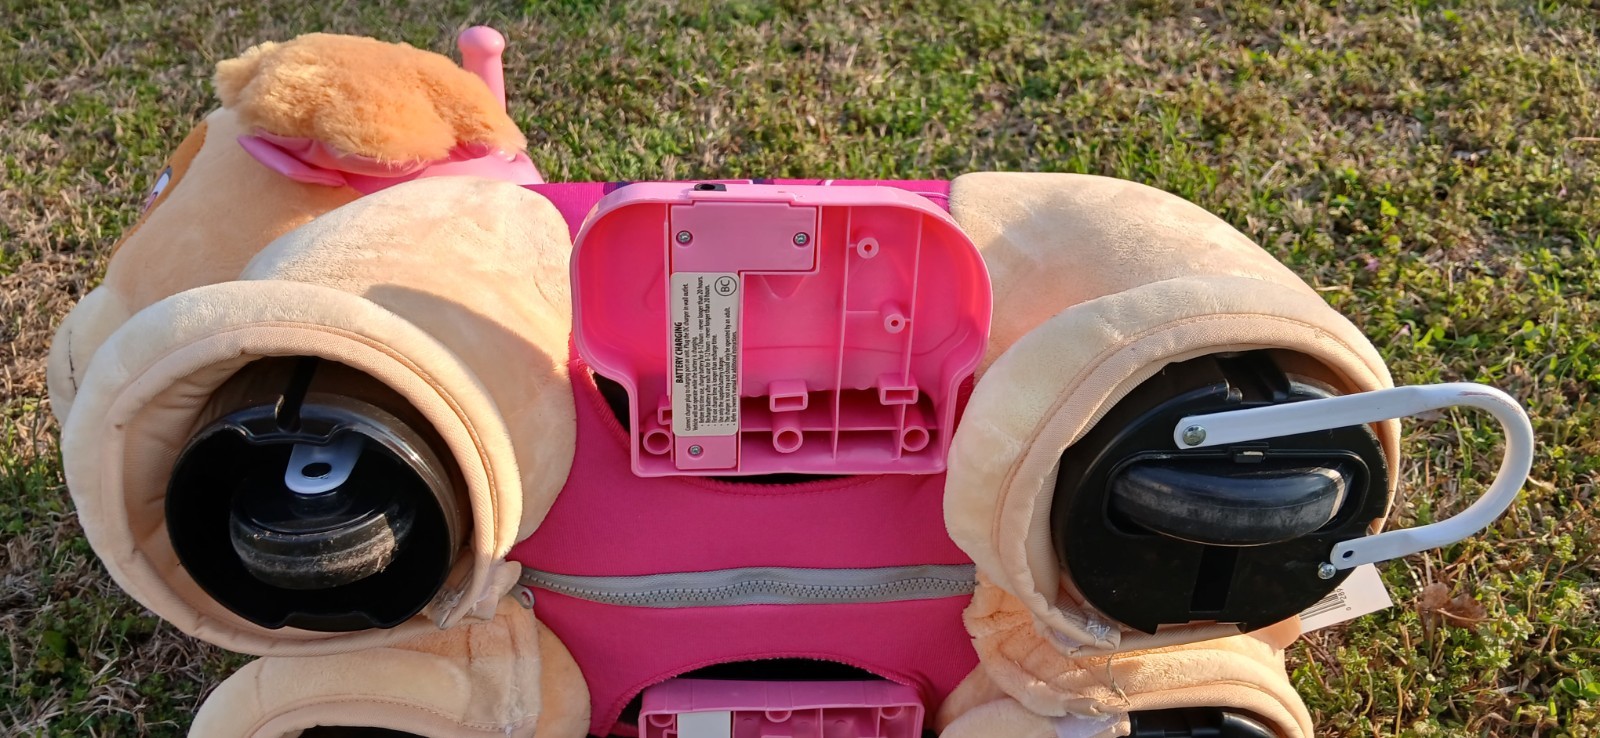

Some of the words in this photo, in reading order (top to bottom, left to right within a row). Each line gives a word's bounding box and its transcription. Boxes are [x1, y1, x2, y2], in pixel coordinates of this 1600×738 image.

[720, 280, 730, 292] BC
[674, 322, 682, 355] CHARGING
[675, 356, 683, 383] BATTERY
